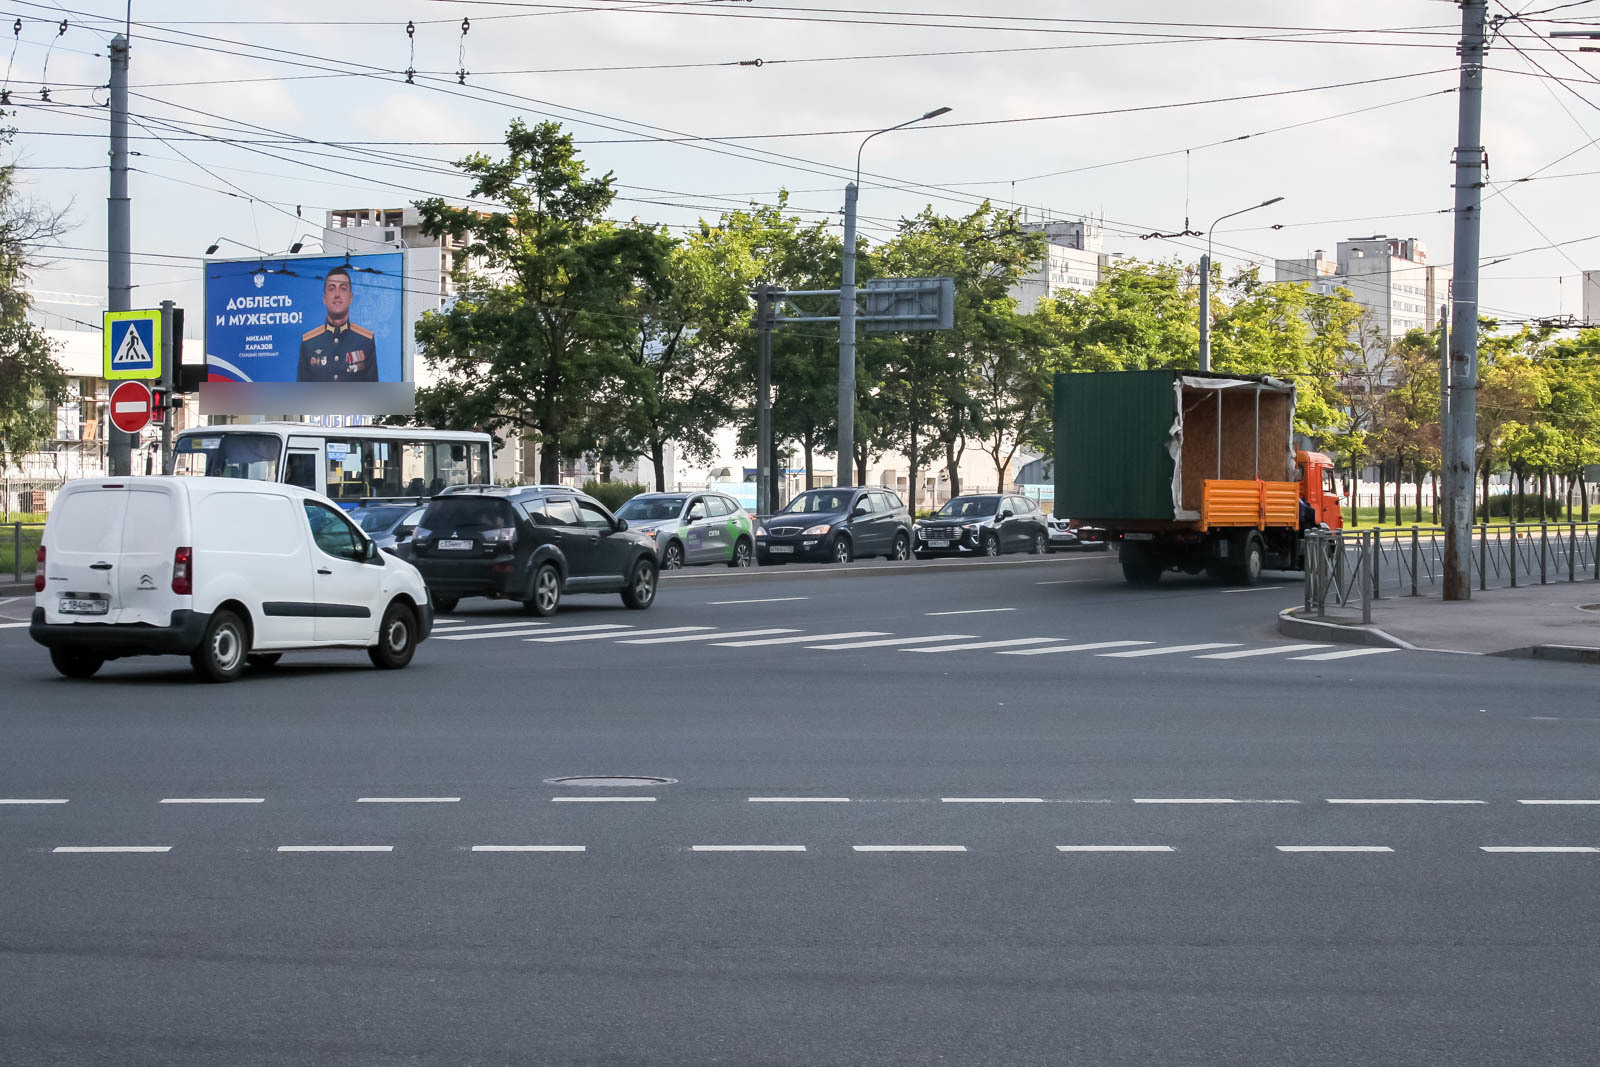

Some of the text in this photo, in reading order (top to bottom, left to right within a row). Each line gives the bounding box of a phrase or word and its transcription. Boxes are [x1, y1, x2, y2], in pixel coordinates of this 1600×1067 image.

[226, 295, 293, 311] ДОБЛЕСТЬ
[216, 312, 303, 326] И МУЖЕСТВО!
